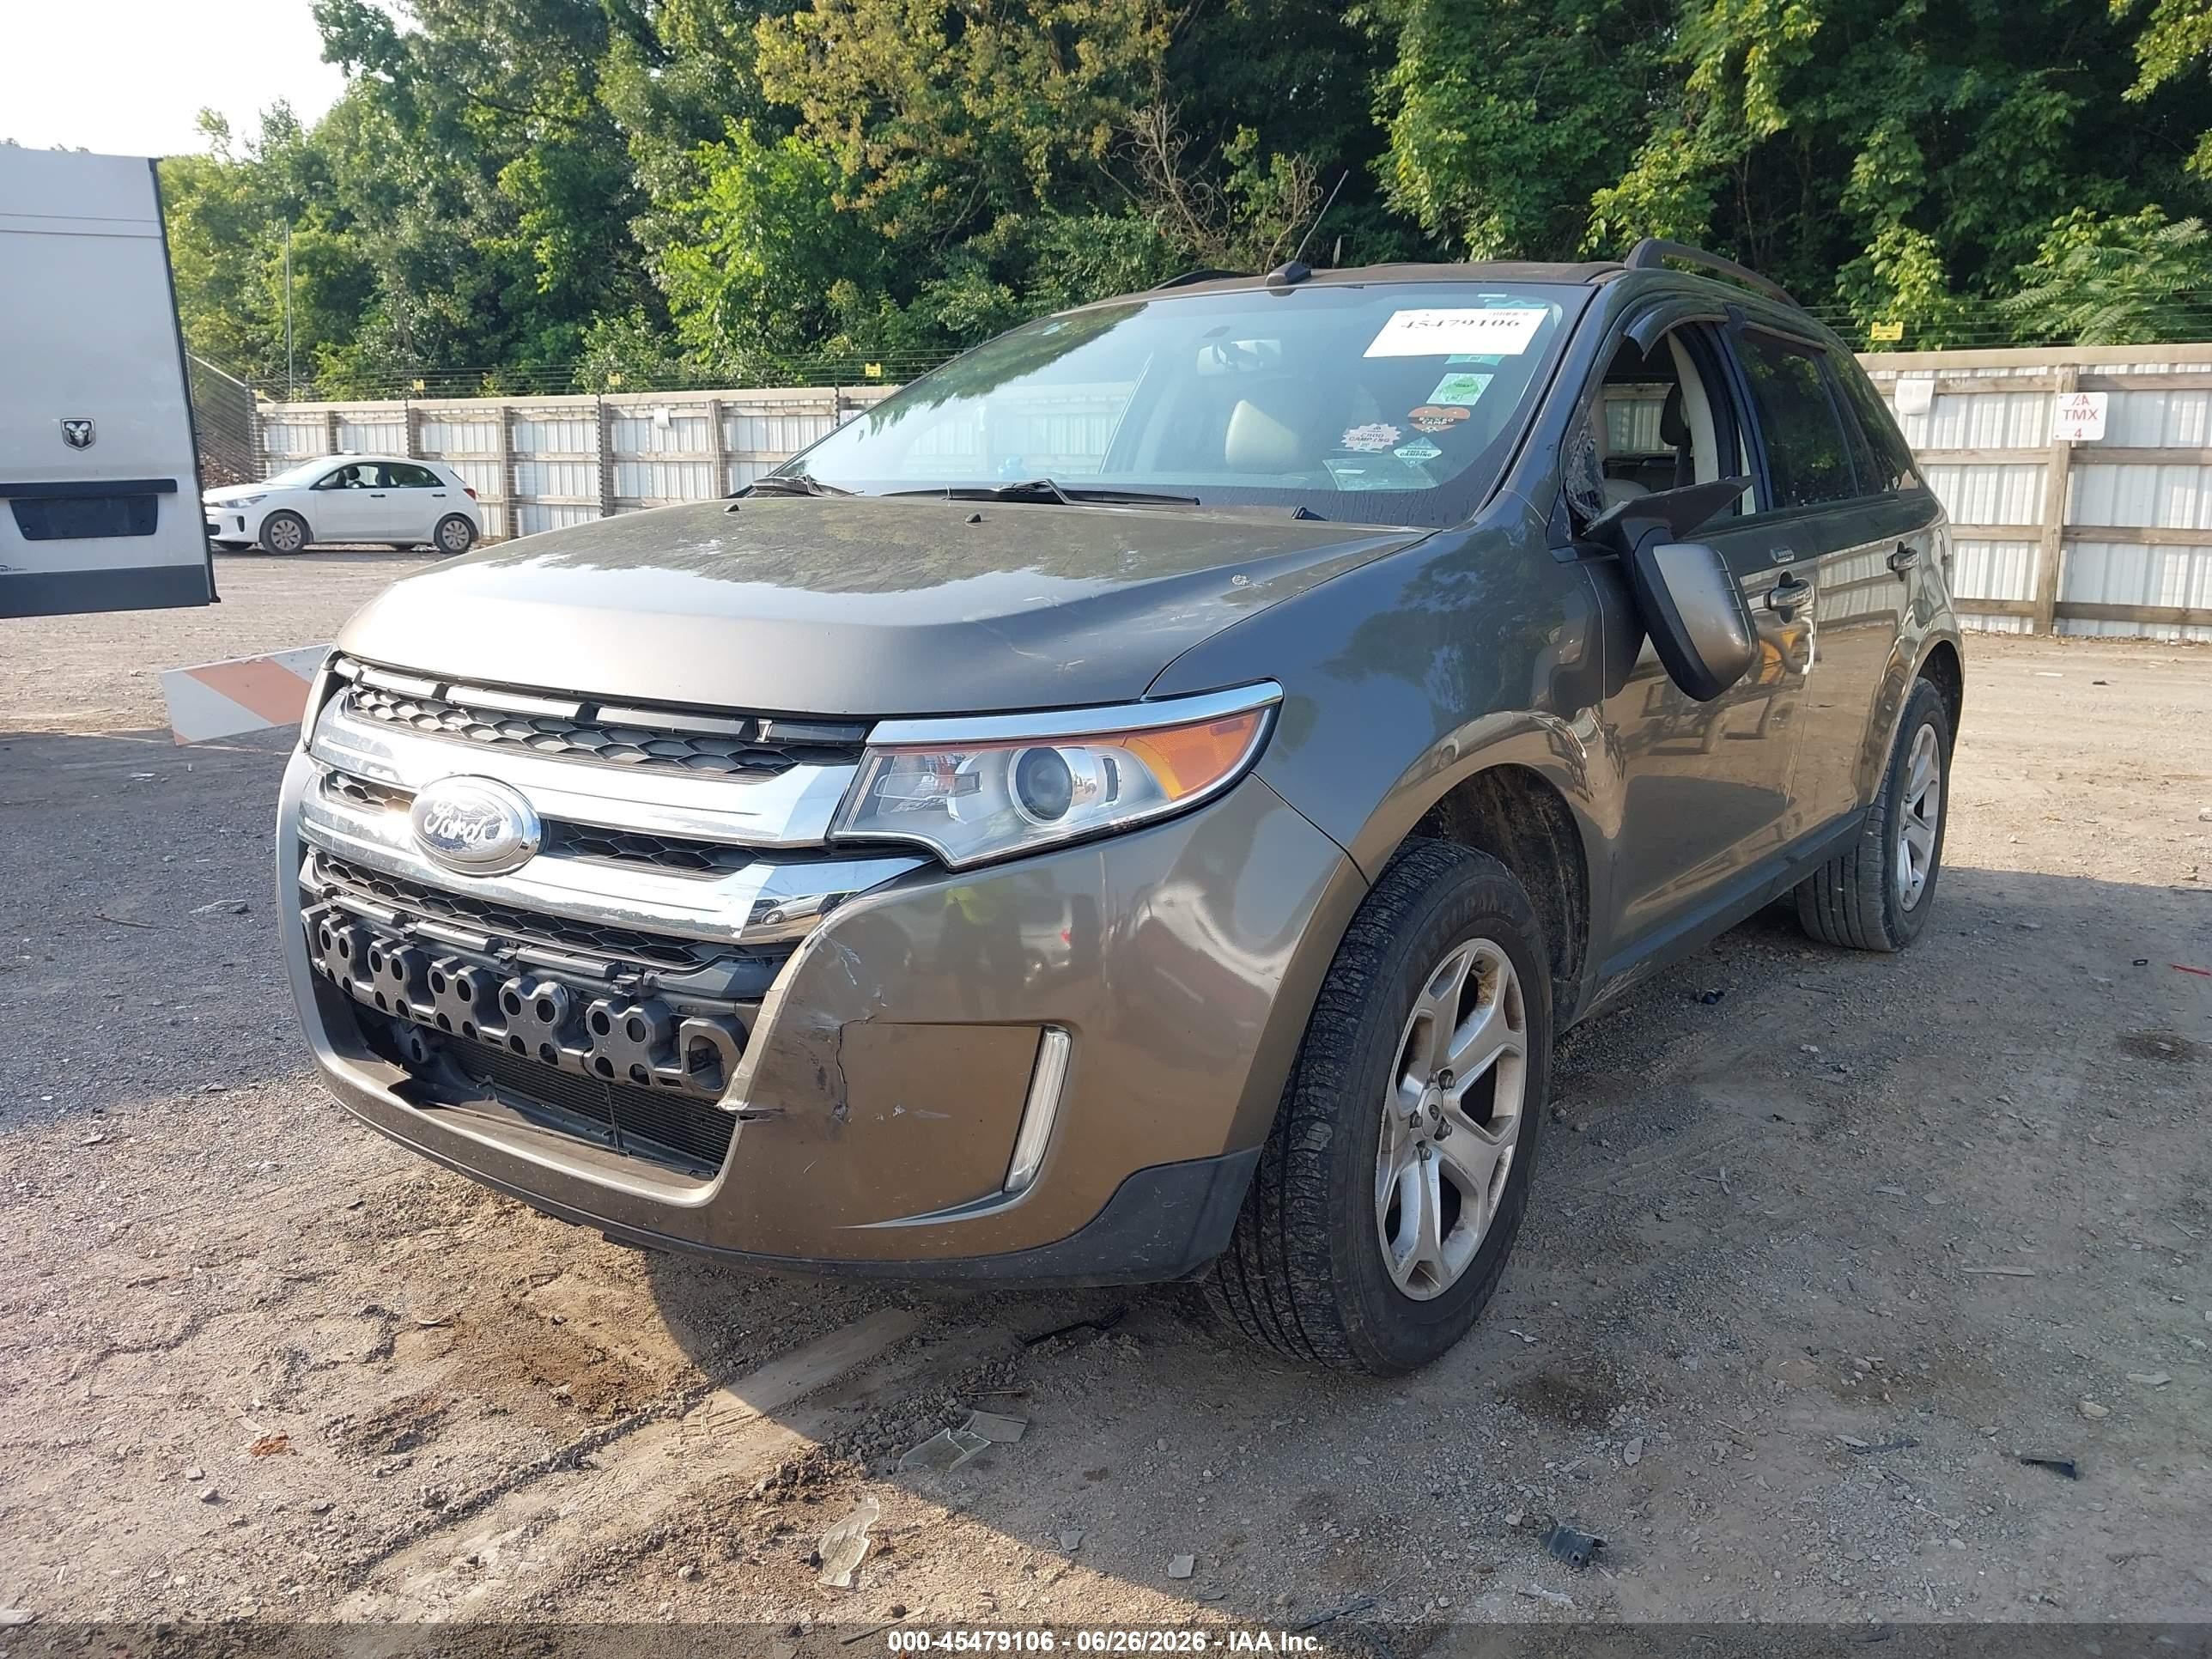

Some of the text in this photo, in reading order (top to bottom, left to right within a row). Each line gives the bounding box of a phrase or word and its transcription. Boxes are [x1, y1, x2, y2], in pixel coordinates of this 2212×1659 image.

[2063, 408, 2099, 421] TMX
[2074, 428, 2082, 439] 4
[423, 800, 508, 844] Ford
